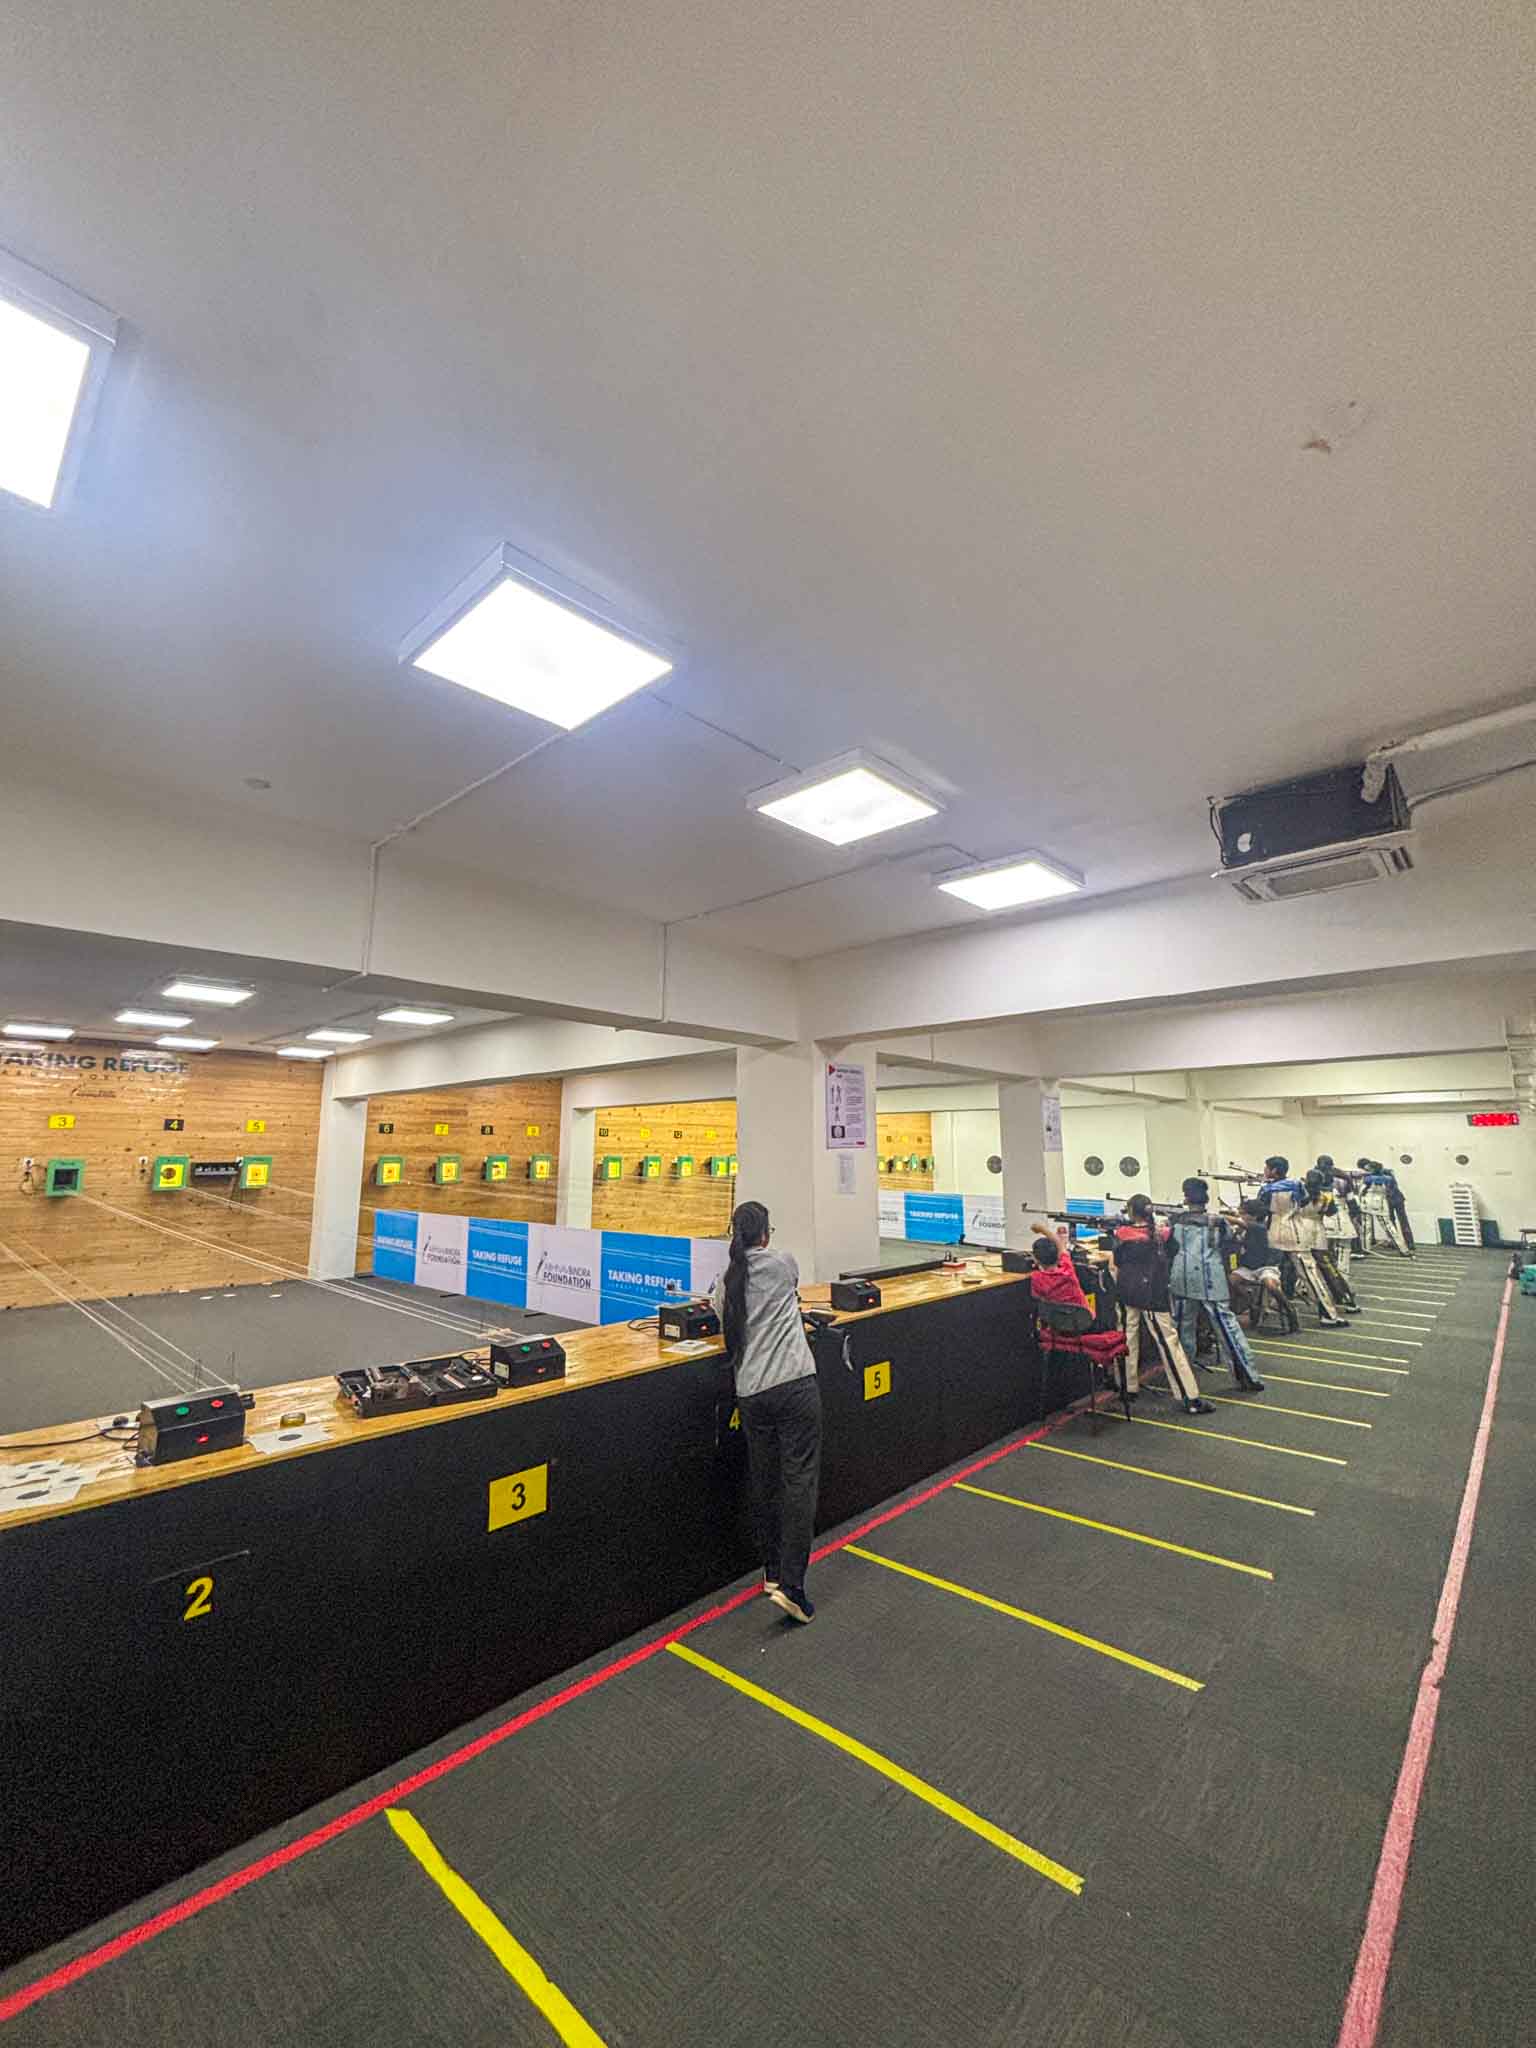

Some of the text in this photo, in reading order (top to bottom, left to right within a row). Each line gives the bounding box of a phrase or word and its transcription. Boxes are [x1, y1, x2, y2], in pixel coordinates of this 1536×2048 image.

[0, 1052, 189, 1073] AKING REFUGE
[168, 1119, 179, 1131] 4
[543, 1271, 592, 1289] FOUNDATION
[607, 1269, 643, 1285] TAKING
[644, 1274, 683, 1292] REFUGE
[874, 1370, 881, 1390] 5
[729, 1407, 740, 1431] 4
[511, 1482, 527, 1511] 3
[183, 1576, 213, 1622] 2
